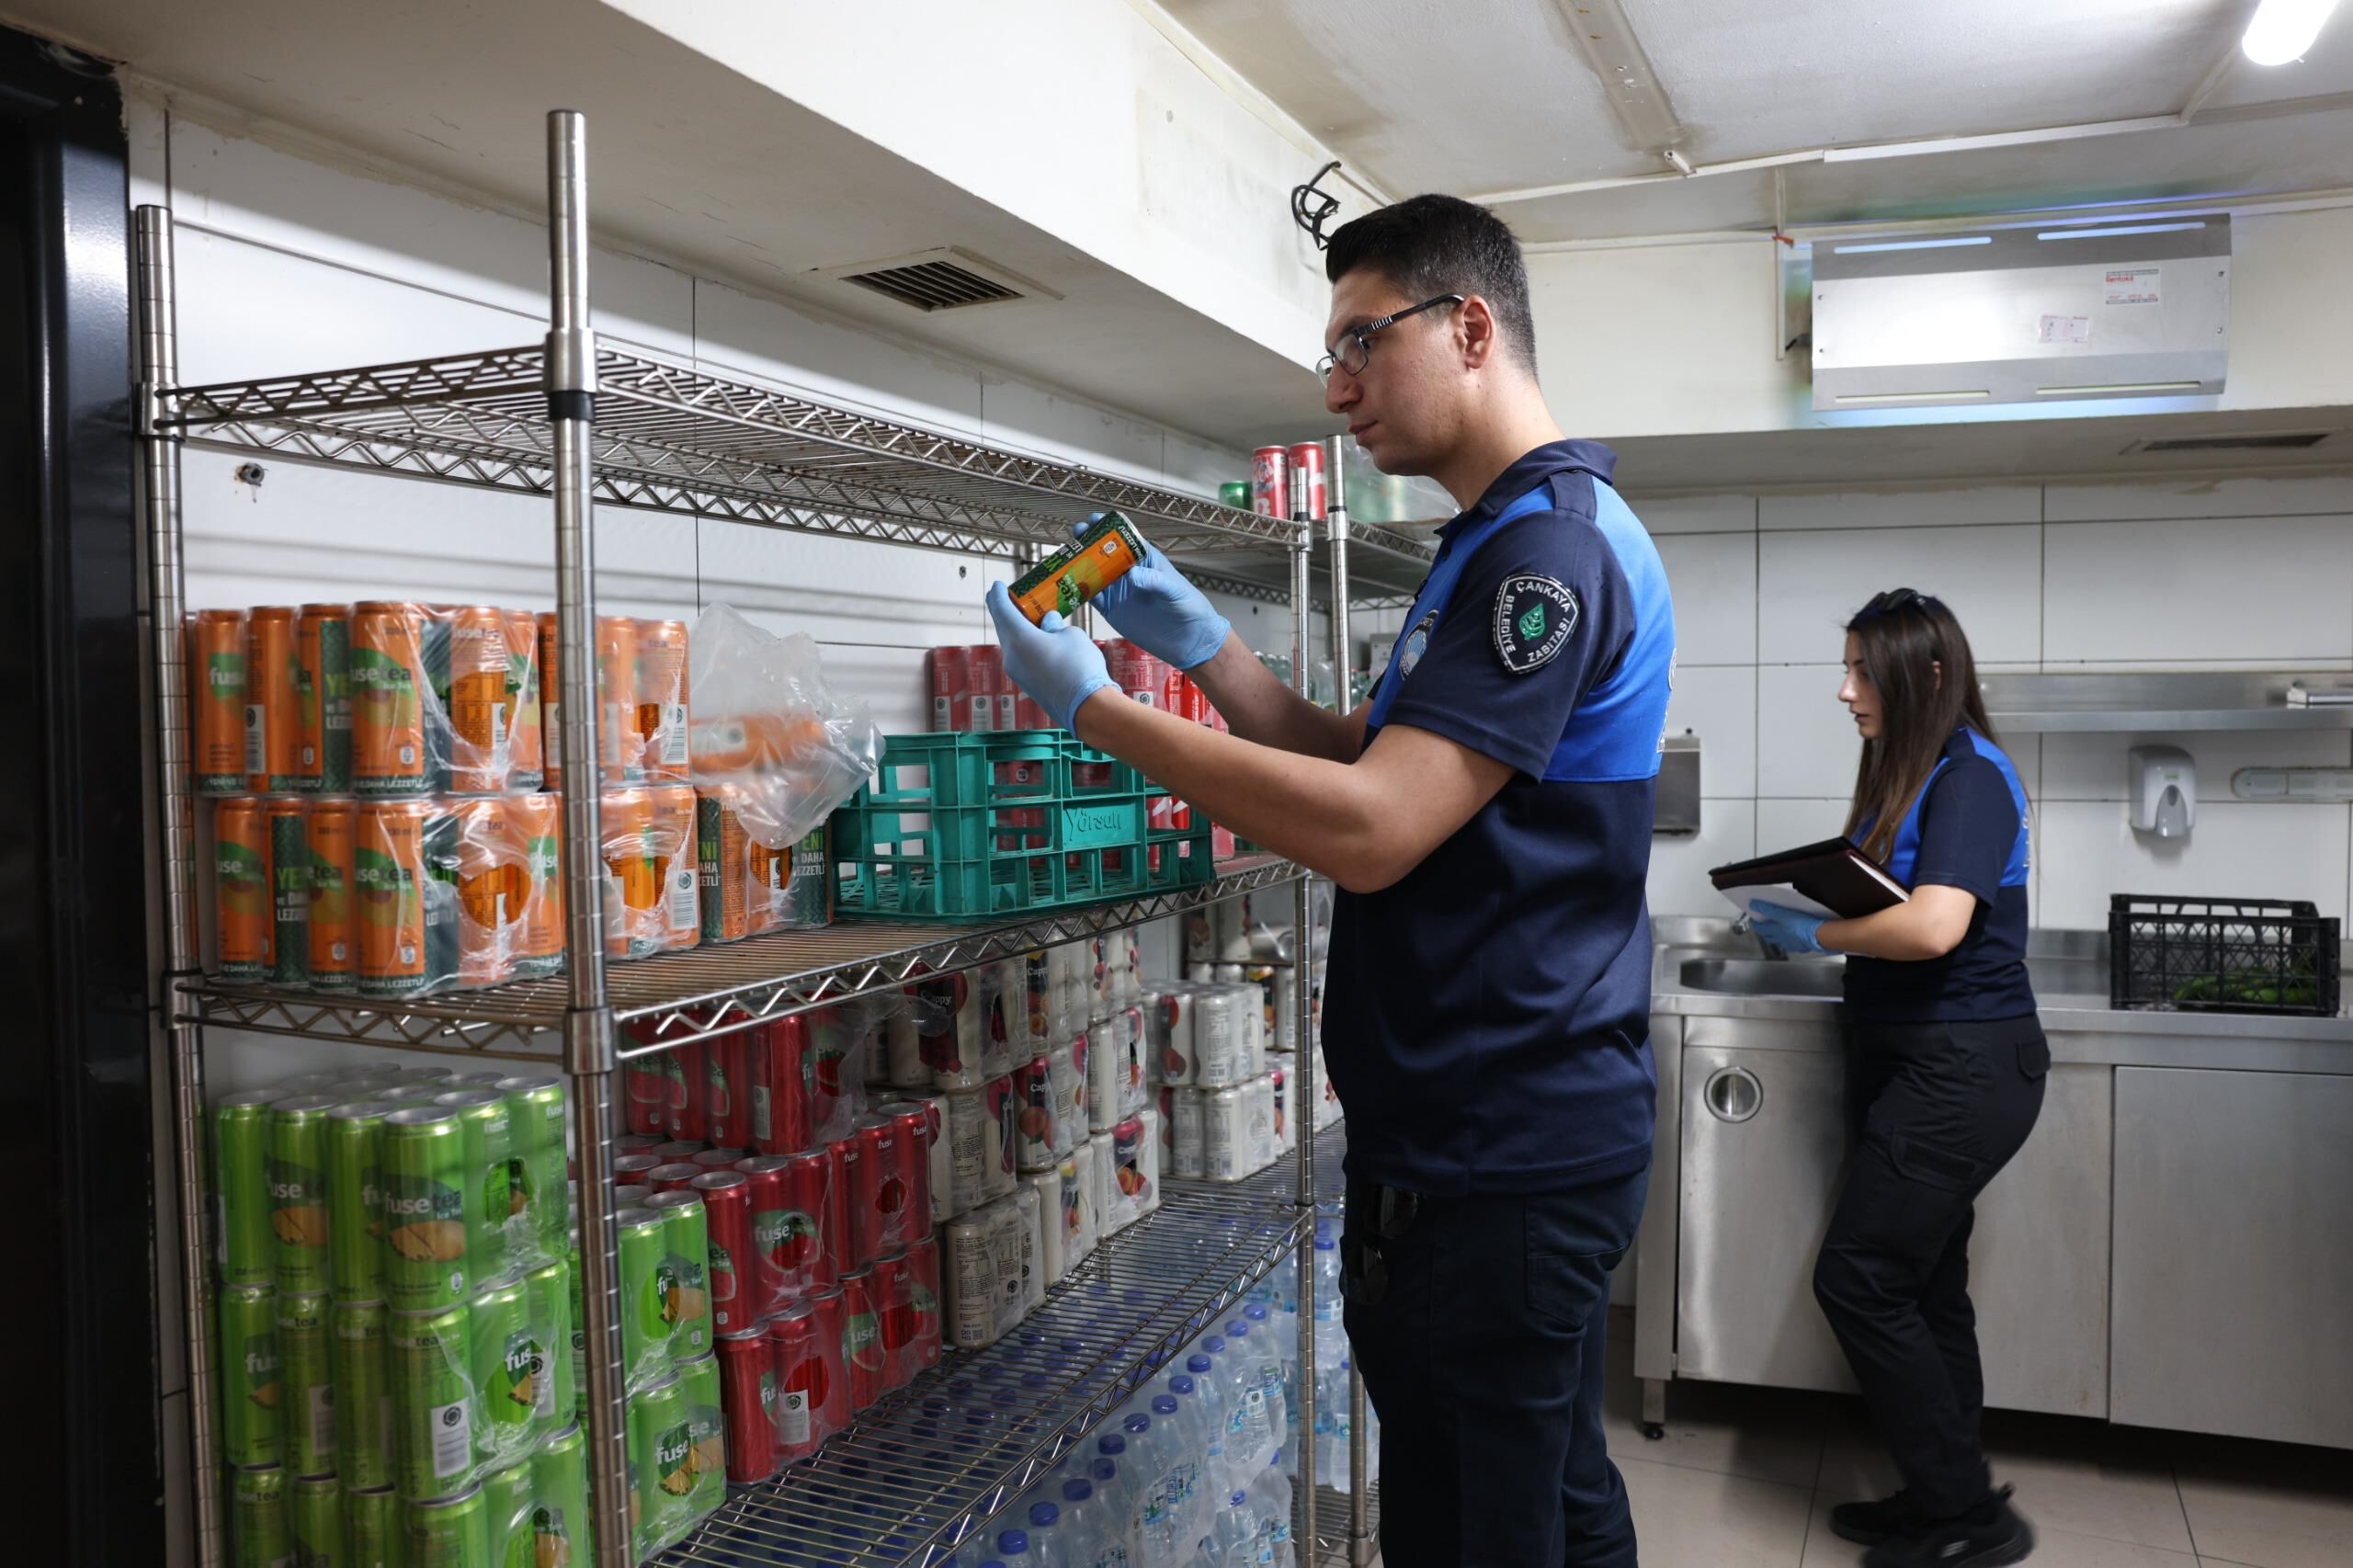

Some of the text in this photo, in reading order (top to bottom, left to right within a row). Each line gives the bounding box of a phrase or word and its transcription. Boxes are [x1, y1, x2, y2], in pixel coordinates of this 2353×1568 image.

[1516, 581, 1571, 613] ÇANKAYA
[1527, 618, 1570, 663] ZABITASI
[754, 1224, 790, 1242] fuse
[656, 1439, 688, 1464] fuse
